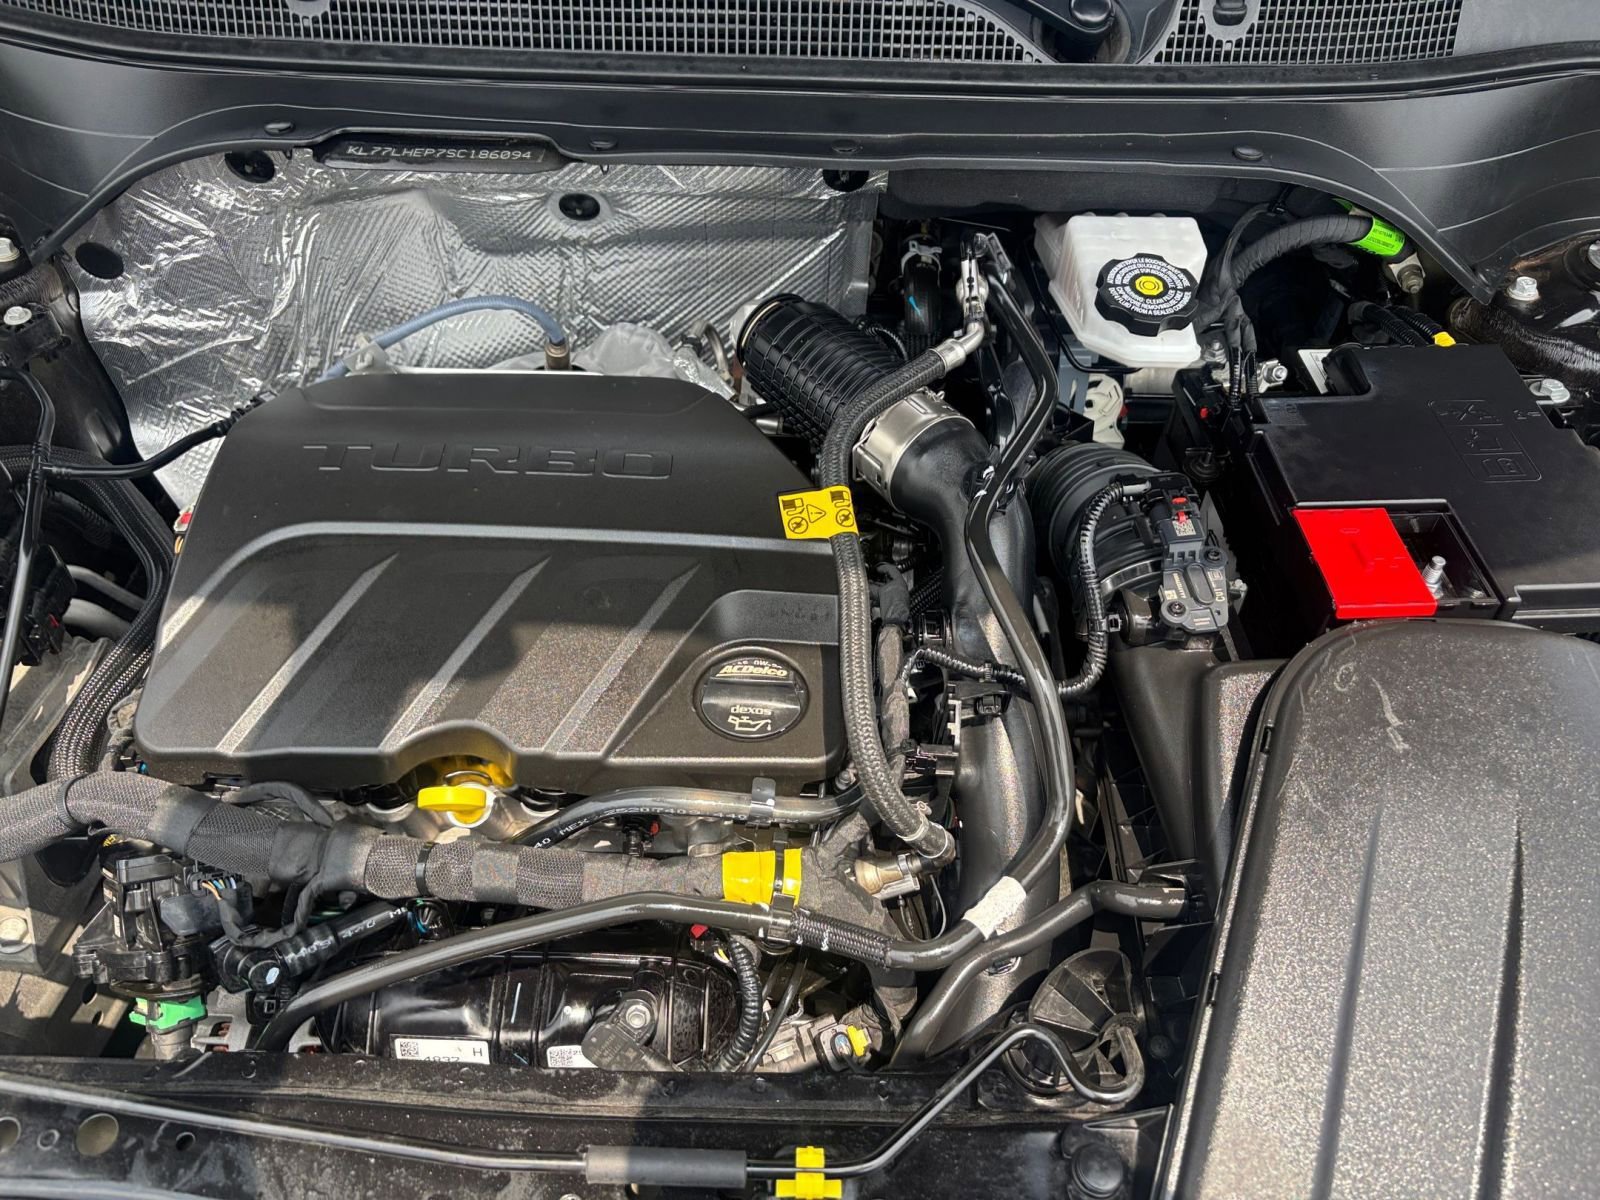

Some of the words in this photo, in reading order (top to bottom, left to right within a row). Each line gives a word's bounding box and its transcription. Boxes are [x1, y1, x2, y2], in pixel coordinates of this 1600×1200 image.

[346, 145, 532, 160] KL77LHEP7SC186094
[302, 443, 674, 480] TURBO
[718, 665, 788, 677] ACDelco
[730, 704, 772, 715] dexos
[559, 818, 590, 836] MEX
[473, 1047, 483, 1057] H
